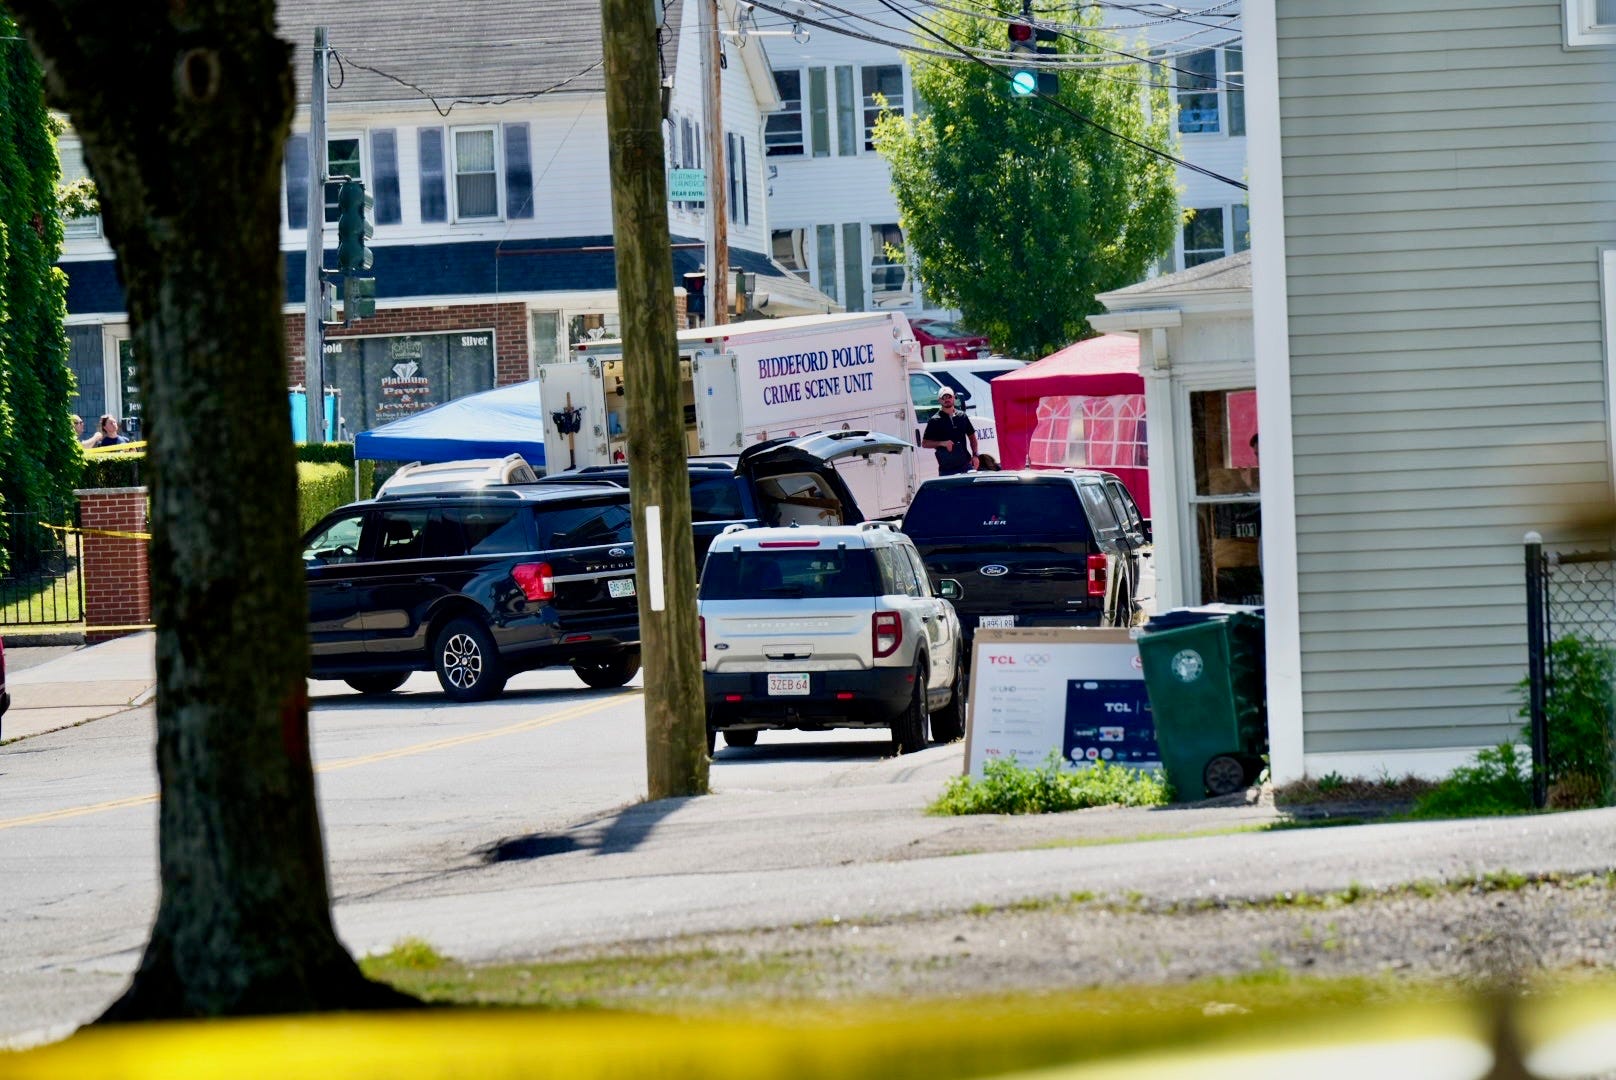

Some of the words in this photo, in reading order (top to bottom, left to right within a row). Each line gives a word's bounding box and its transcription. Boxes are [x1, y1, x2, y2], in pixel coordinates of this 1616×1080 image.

[461, 336, 488, 347] Silver
[758, 350, 828, 380] BIDDEFORD
[831, 343, 875, 369] POLICE
[381, 376, 429, 386] Platinum
[383, 387, 431, 396] Pawn
[763, 382, 802, 406] CRIME
[804, 377, 841, 400] SCENE
[843, 372, 873, 394] UNIT
[401, 394, 412, 403] &
[375, 402, 439, 412] Jewelry
[974, 427, 995, 440] OLICE
[586, 561, 635, 572] EXPEDIT
[988, 655, 1016, 665] TCL
[770, 679, 794, 691] 3ZEB
[796, 679, 808, 691] 64
[1104, 702, 1132, 713] TCL
